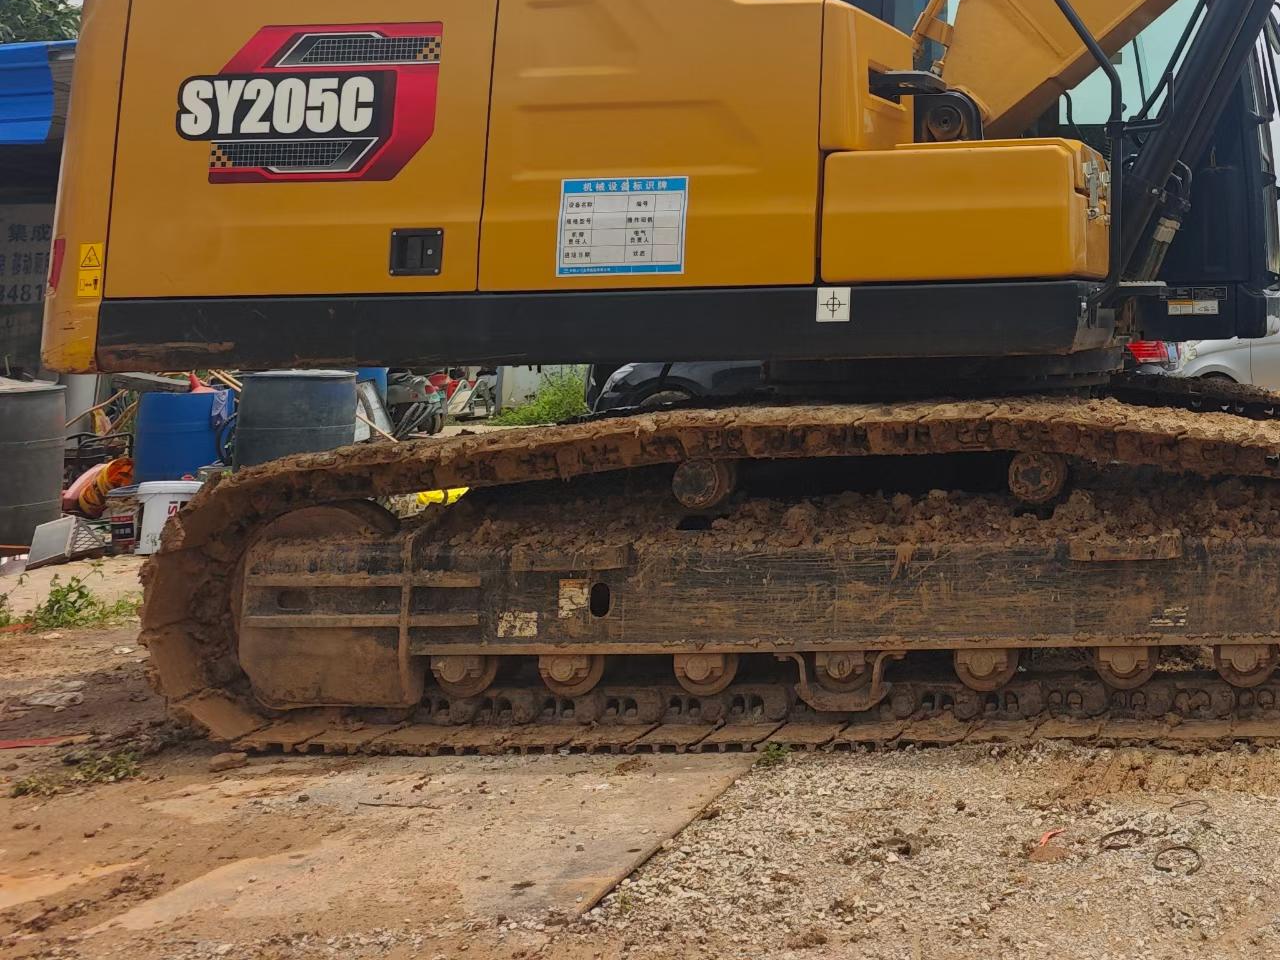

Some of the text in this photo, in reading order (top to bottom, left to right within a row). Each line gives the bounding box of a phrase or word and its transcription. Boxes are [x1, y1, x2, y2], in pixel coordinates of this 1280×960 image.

[180, 76, 375, 136] SY205C
[583, 180, 668, 192] 机械设备标识牌
